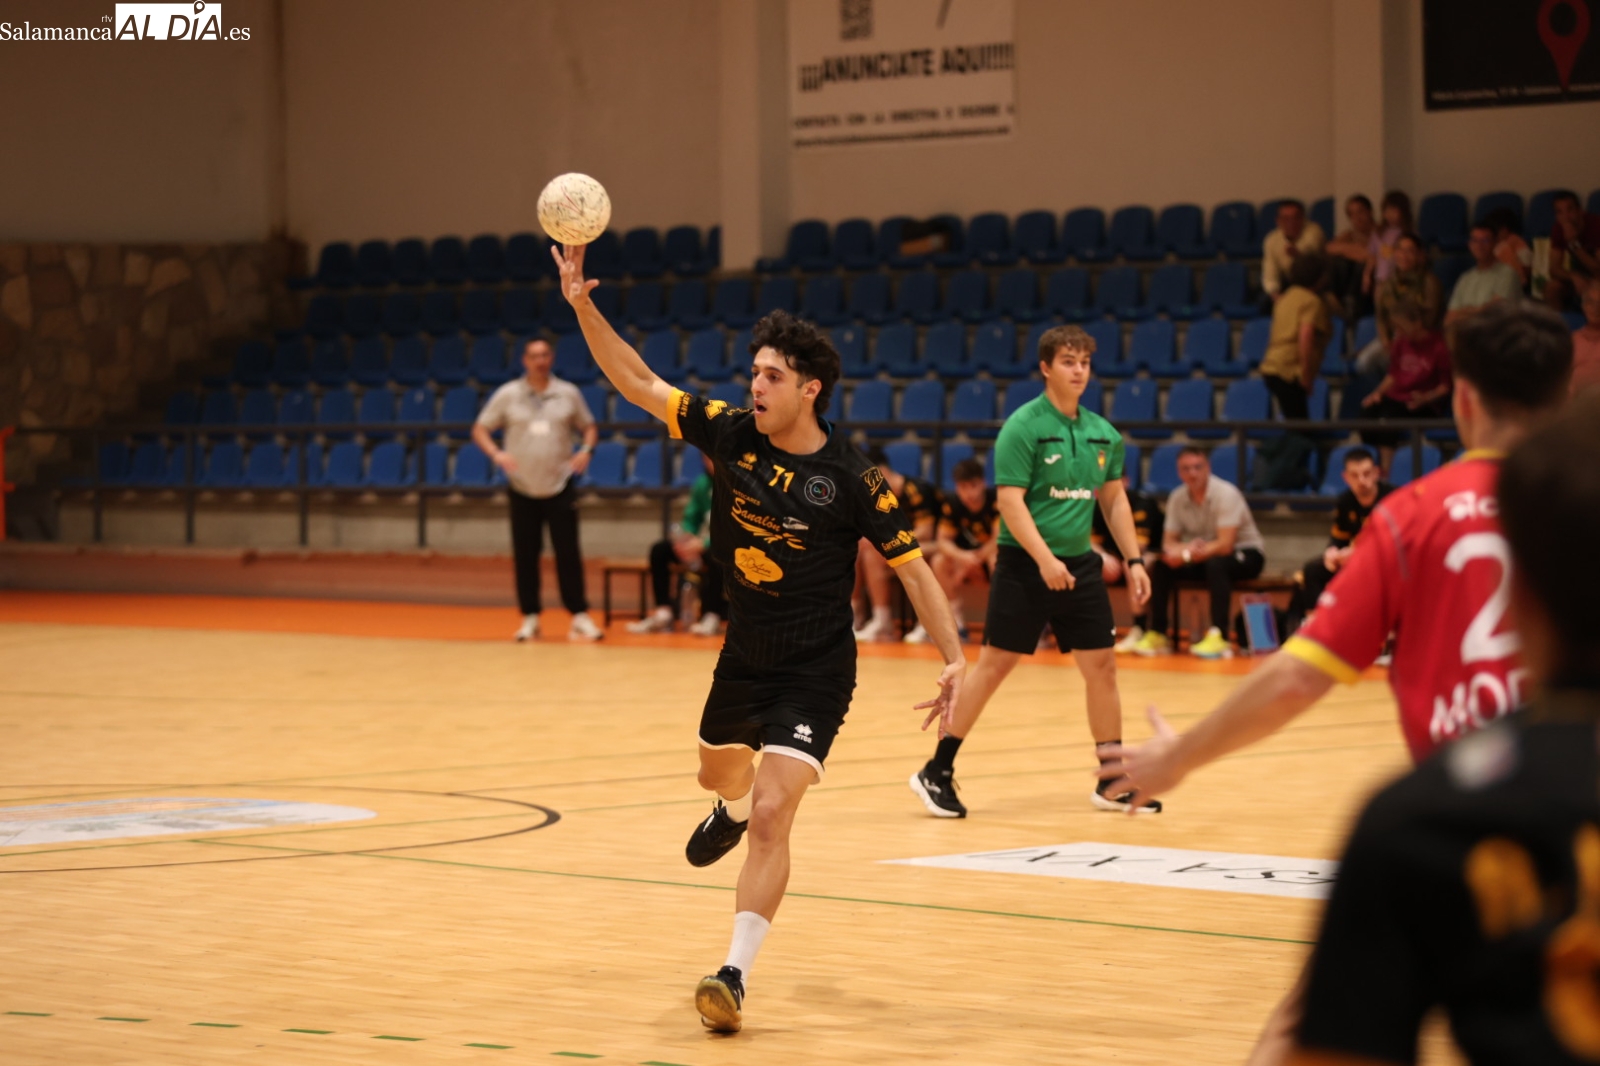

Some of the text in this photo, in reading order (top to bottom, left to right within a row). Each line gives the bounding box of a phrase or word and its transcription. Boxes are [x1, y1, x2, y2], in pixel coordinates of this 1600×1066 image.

[768, 464, 794, 492] 71
[732, 488, 761, 507] AUTOCARES
[1049, 485, 1091, 500] helvetia
[731, 496, 781, 532] Sanalón
